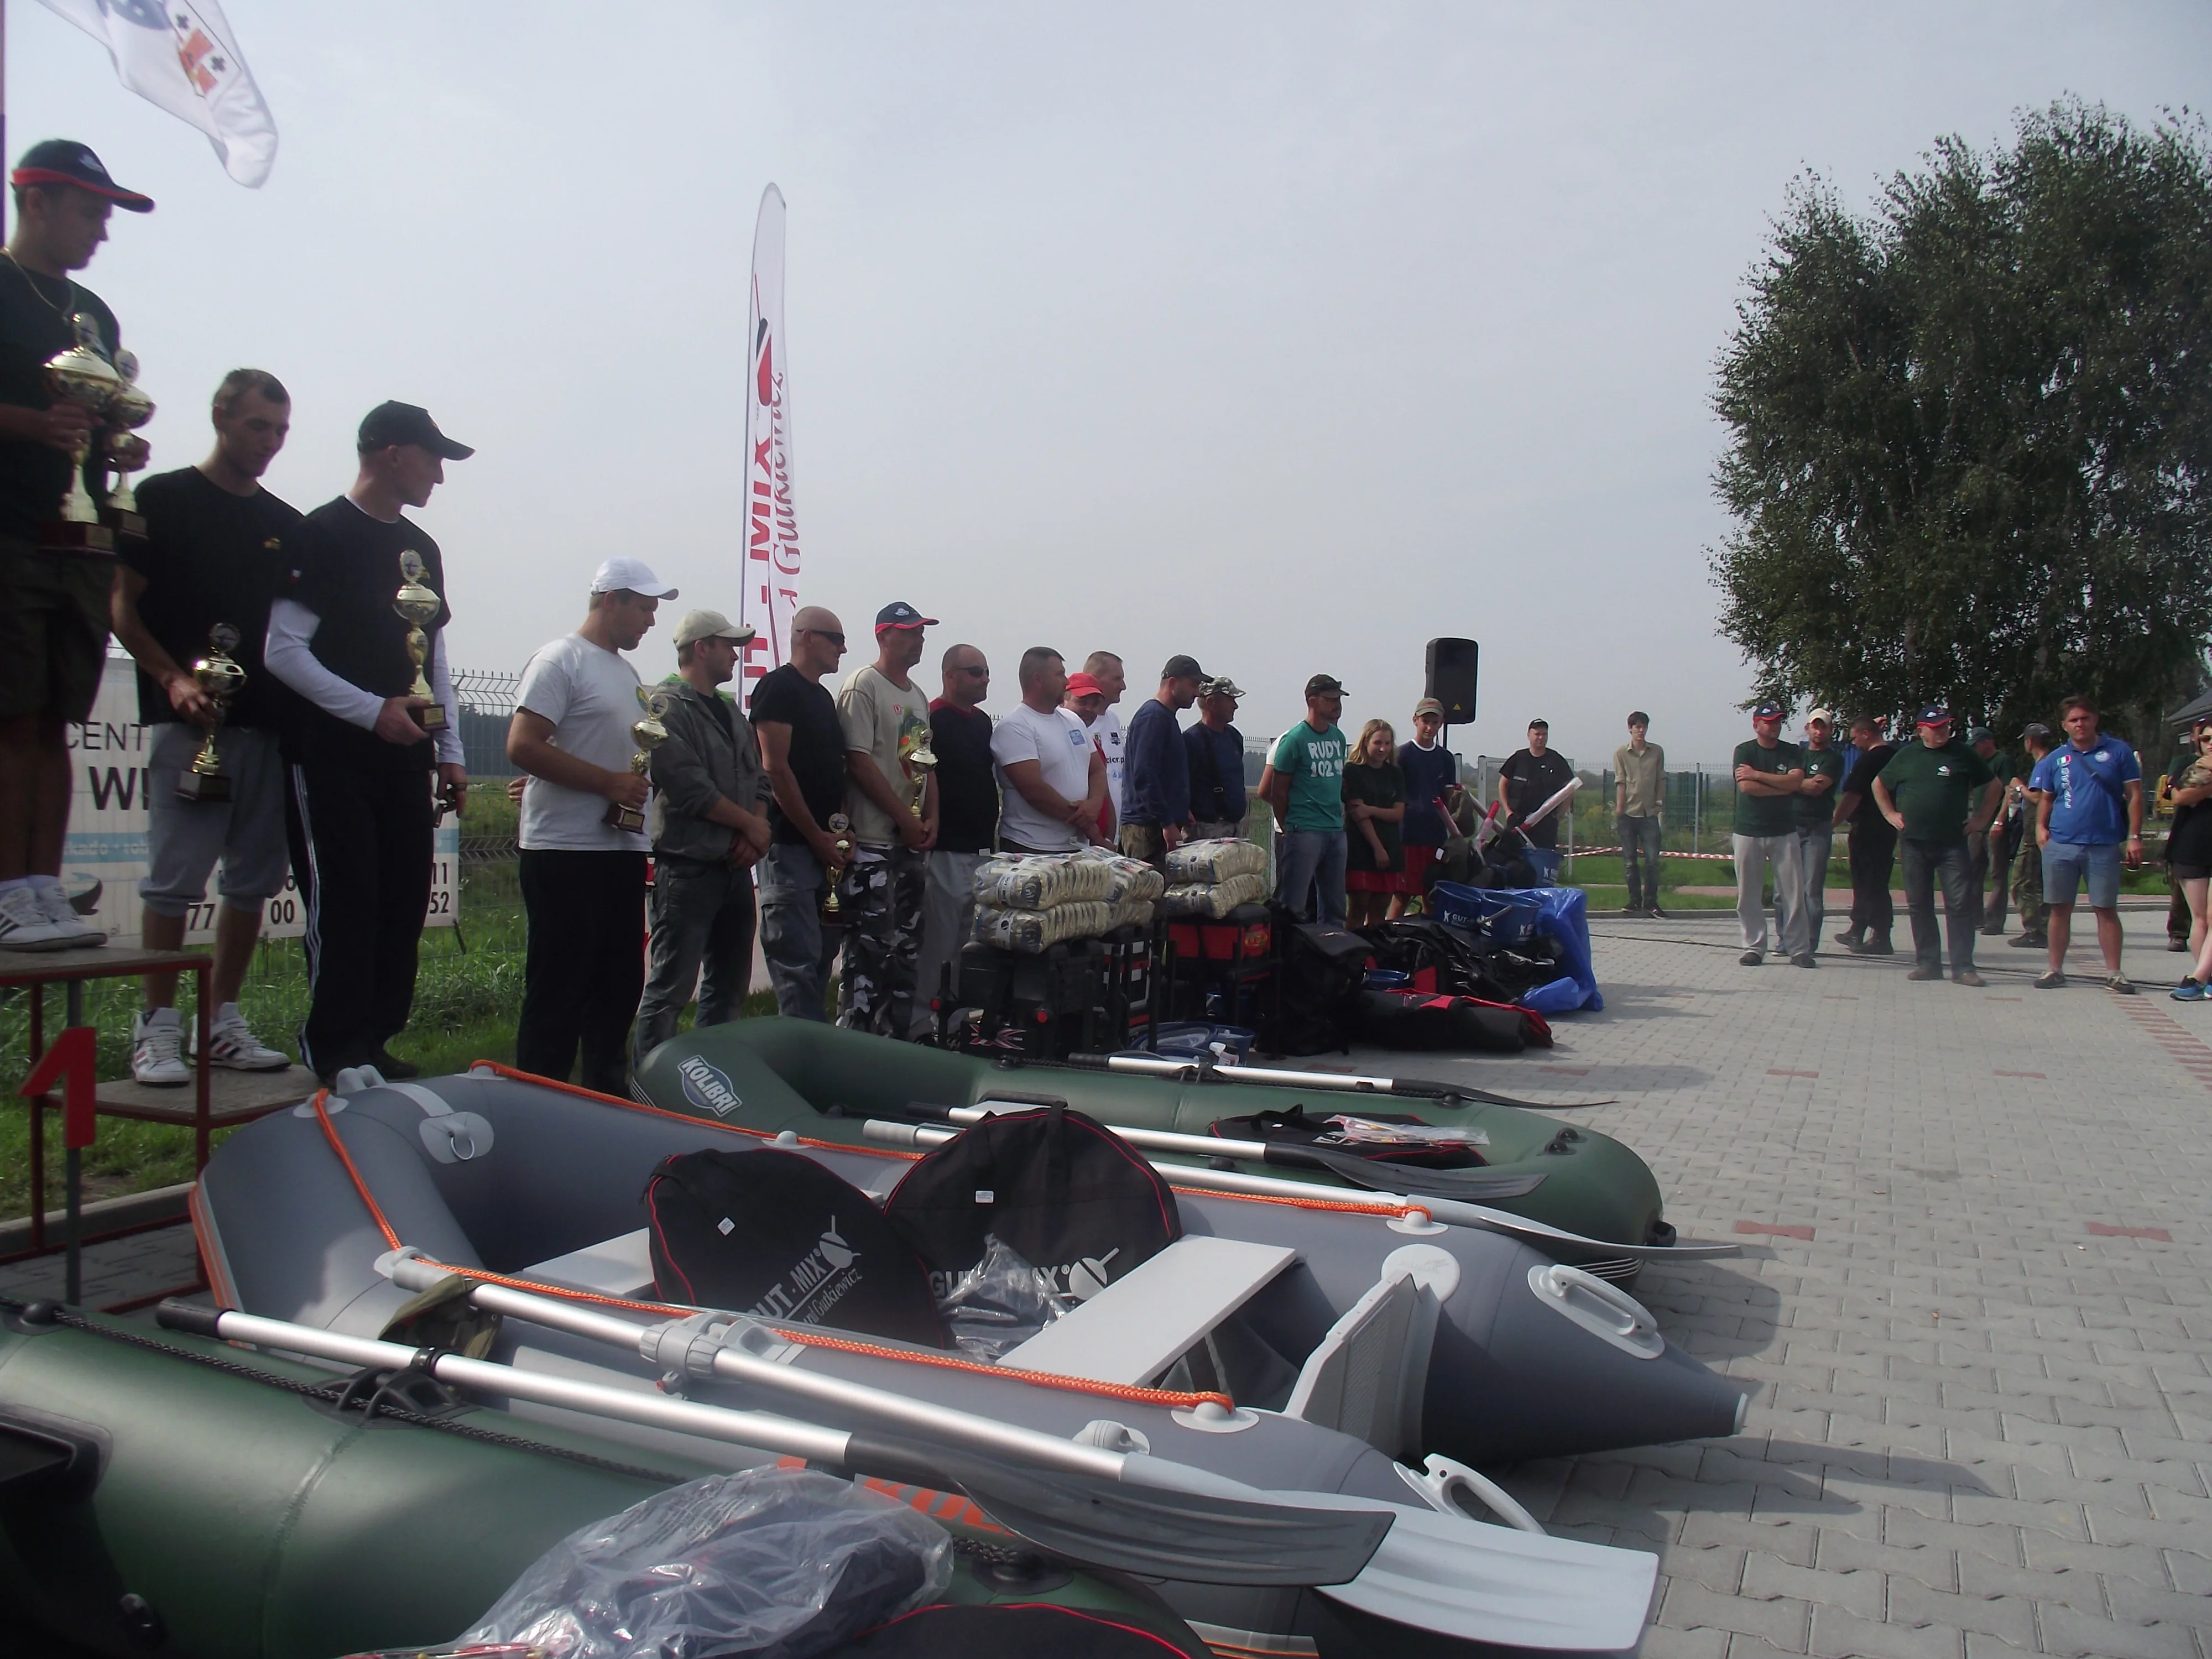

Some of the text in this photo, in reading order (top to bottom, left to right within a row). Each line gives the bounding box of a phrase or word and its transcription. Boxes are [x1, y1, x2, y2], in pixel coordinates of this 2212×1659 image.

[1307, 739, 1341, 760] RUDY
[1310, 760, 1335, 778] 102
[188, 891, 450, 930] 77 00 52
[19, 1026, 96, 1150] 1
[681, 1057, 739, 1114] KOLIBRI
